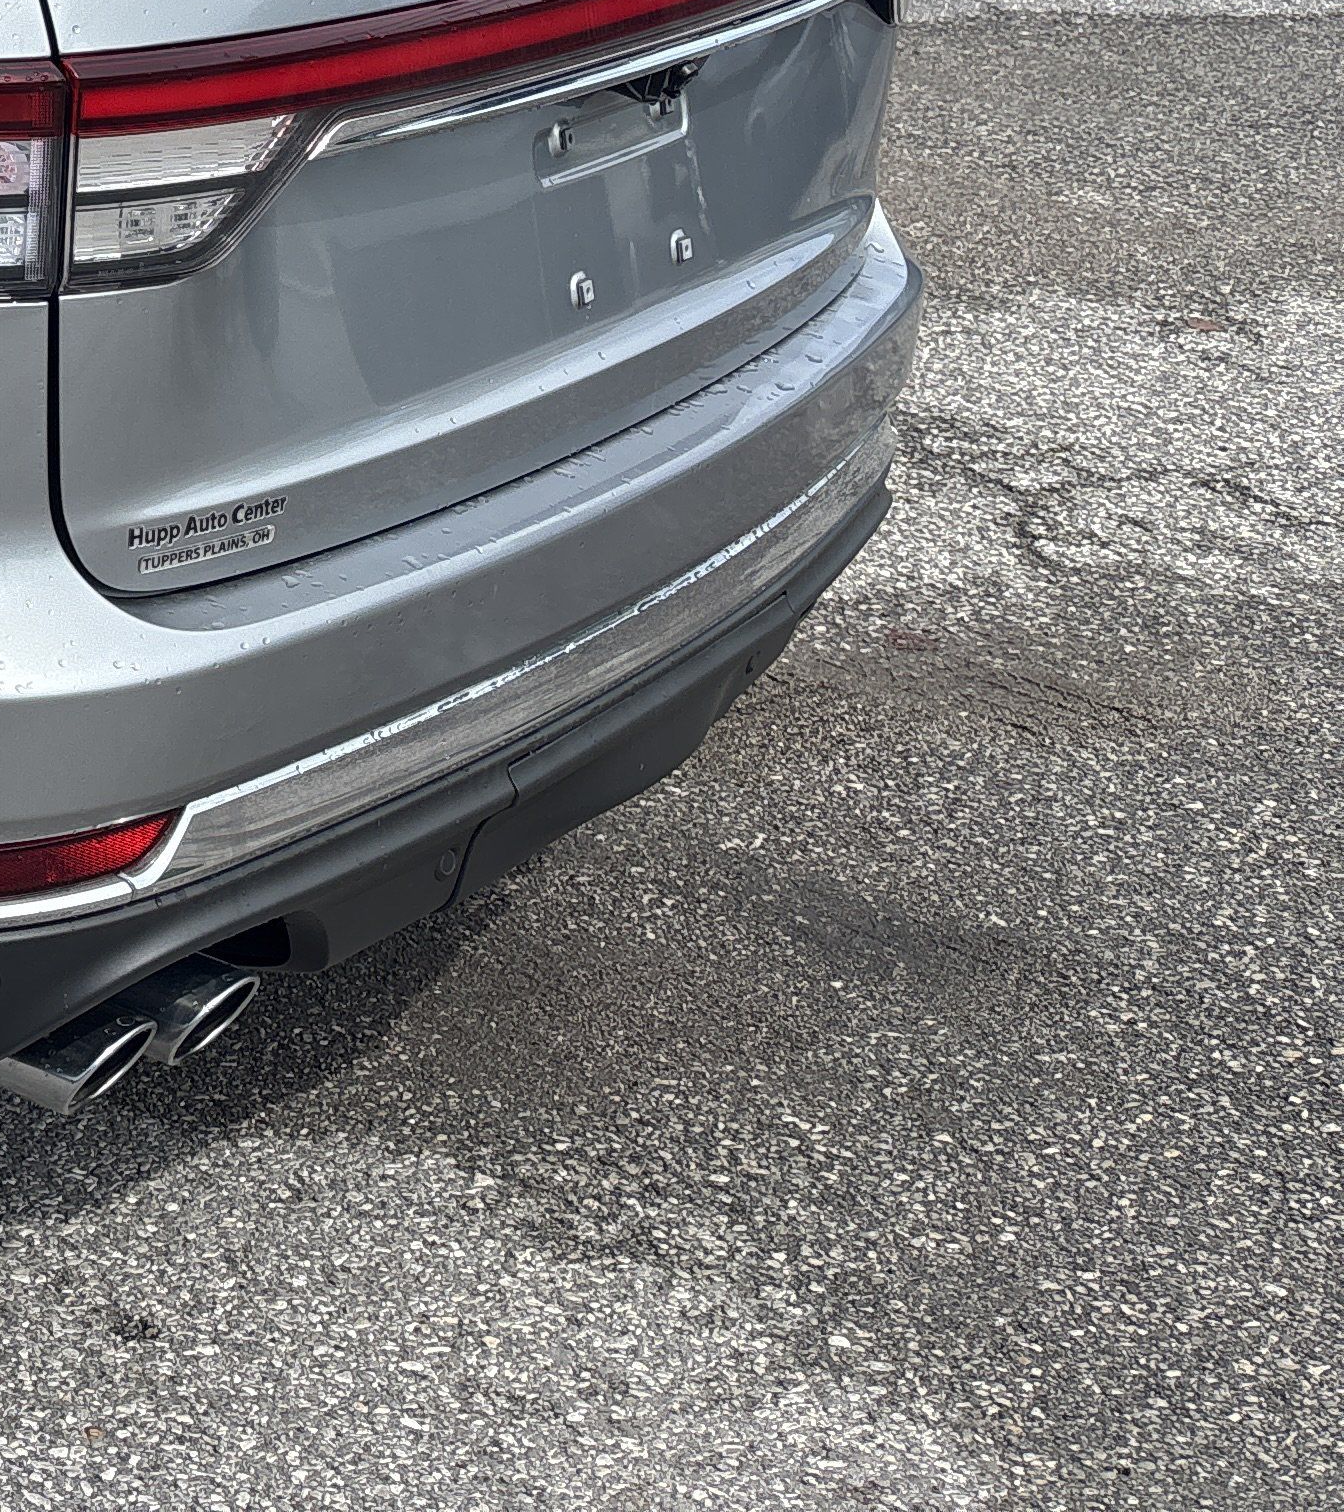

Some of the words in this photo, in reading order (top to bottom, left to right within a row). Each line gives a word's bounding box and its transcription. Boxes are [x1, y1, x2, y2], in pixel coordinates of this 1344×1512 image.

[128, 525, 180, 549] Hupp
[183, 512, 228, 538] Auto
[231, 496, 288, 524] Center
[143, 549, 201, 571] TUPPERS
[202, 537, 250, 558] PLAINS,
[252, 529, 271, 545] OH
